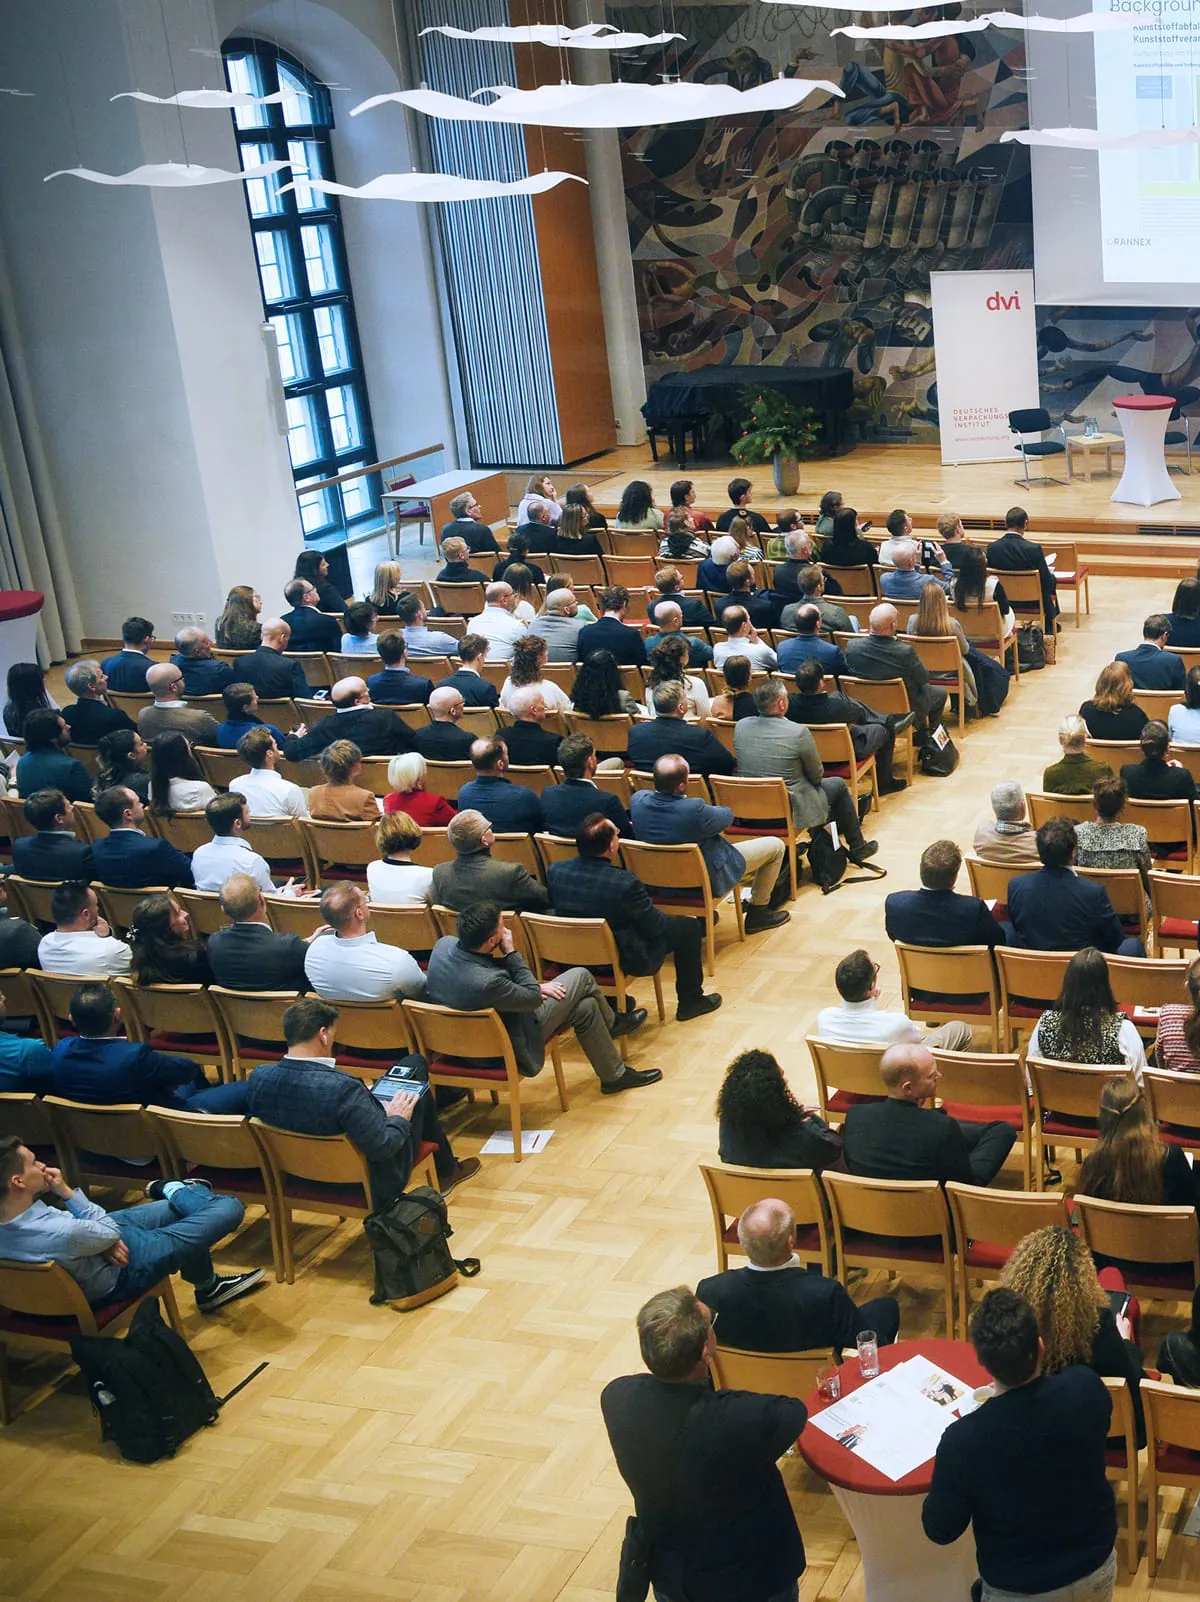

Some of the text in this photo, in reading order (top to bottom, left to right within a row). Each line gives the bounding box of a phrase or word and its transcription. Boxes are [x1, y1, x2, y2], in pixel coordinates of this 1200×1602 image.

[986, 290, 1021, 311] dvi
[953, 407, 999, 415] DEUTSCHES
[954, 421, 991, 429] INSTITUT
